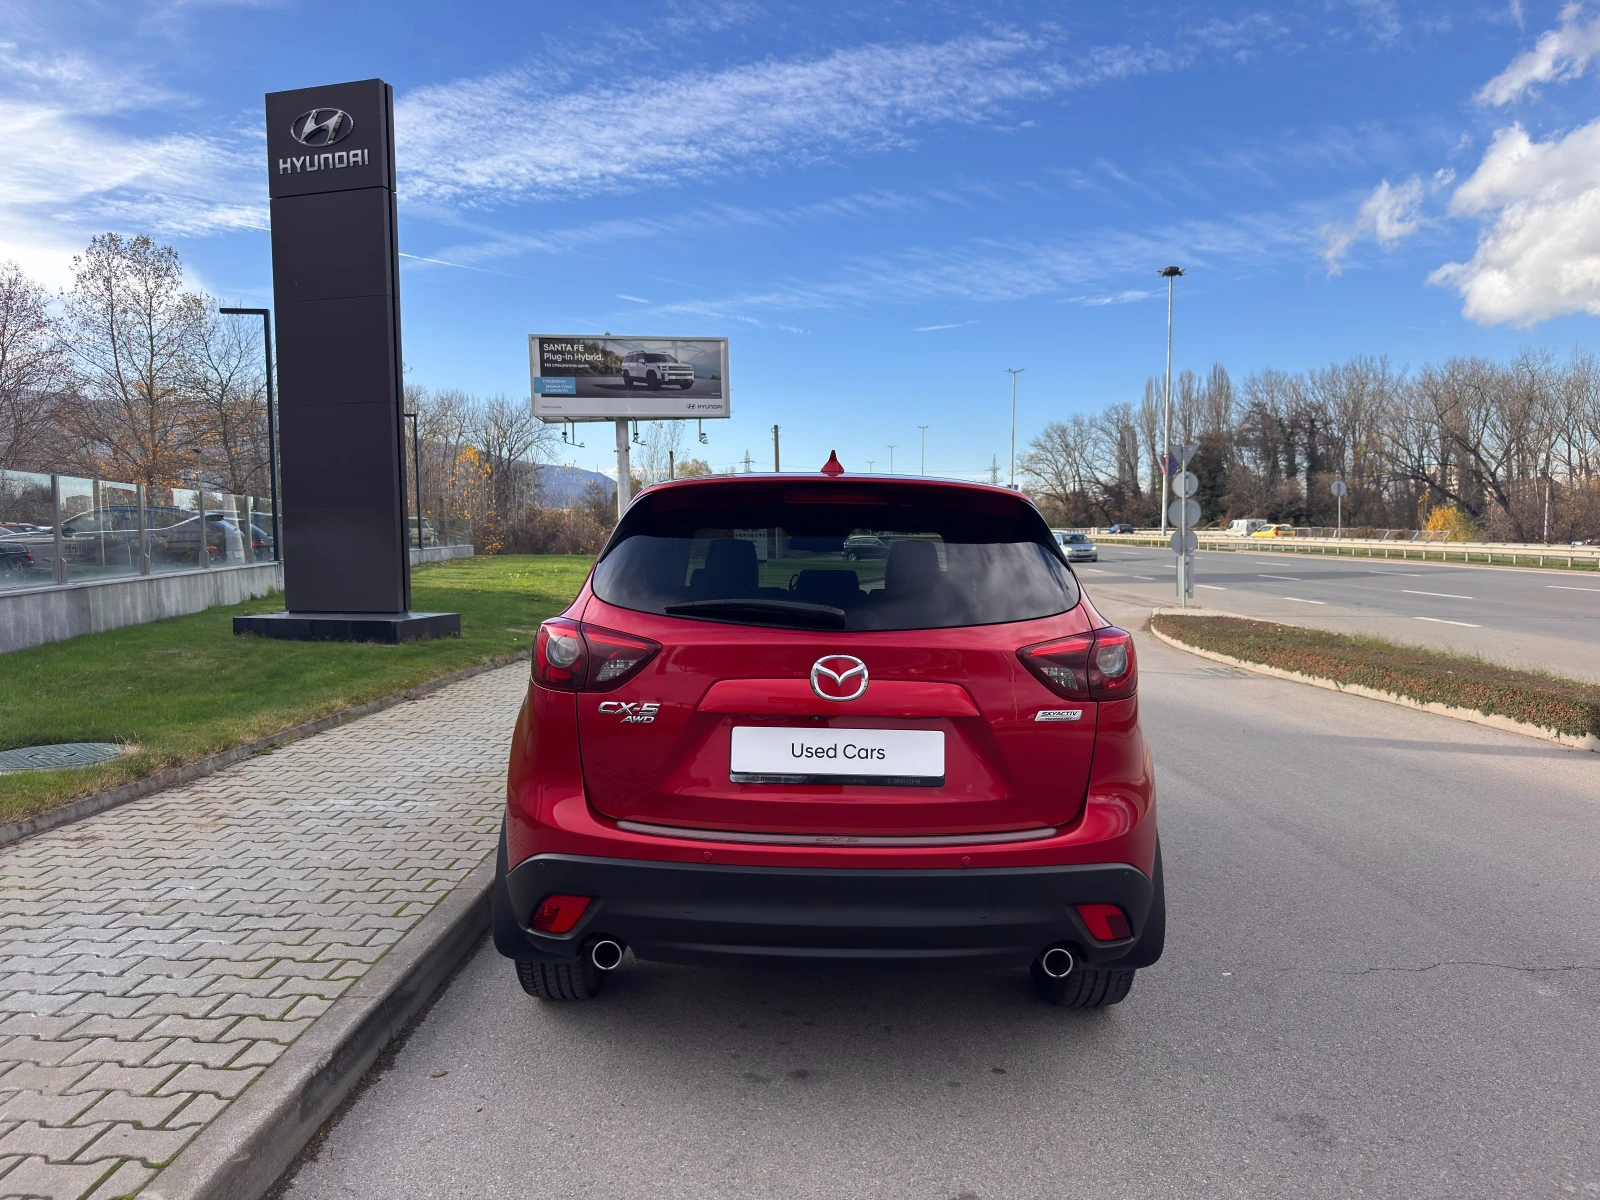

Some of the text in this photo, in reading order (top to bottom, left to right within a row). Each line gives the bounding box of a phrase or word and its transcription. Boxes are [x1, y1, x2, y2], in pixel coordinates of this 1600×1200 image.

[279, 149, 369, 175] HYUNDAI
[543, 343, 585, 352] SANTA FE
[544, 352, 604, 363] Plug-in Hybrid.
[598, 701, 662, 716] CX-5
[620, 715, 655, 724] AWD
[791, 742, 886, 760] Used Cars
